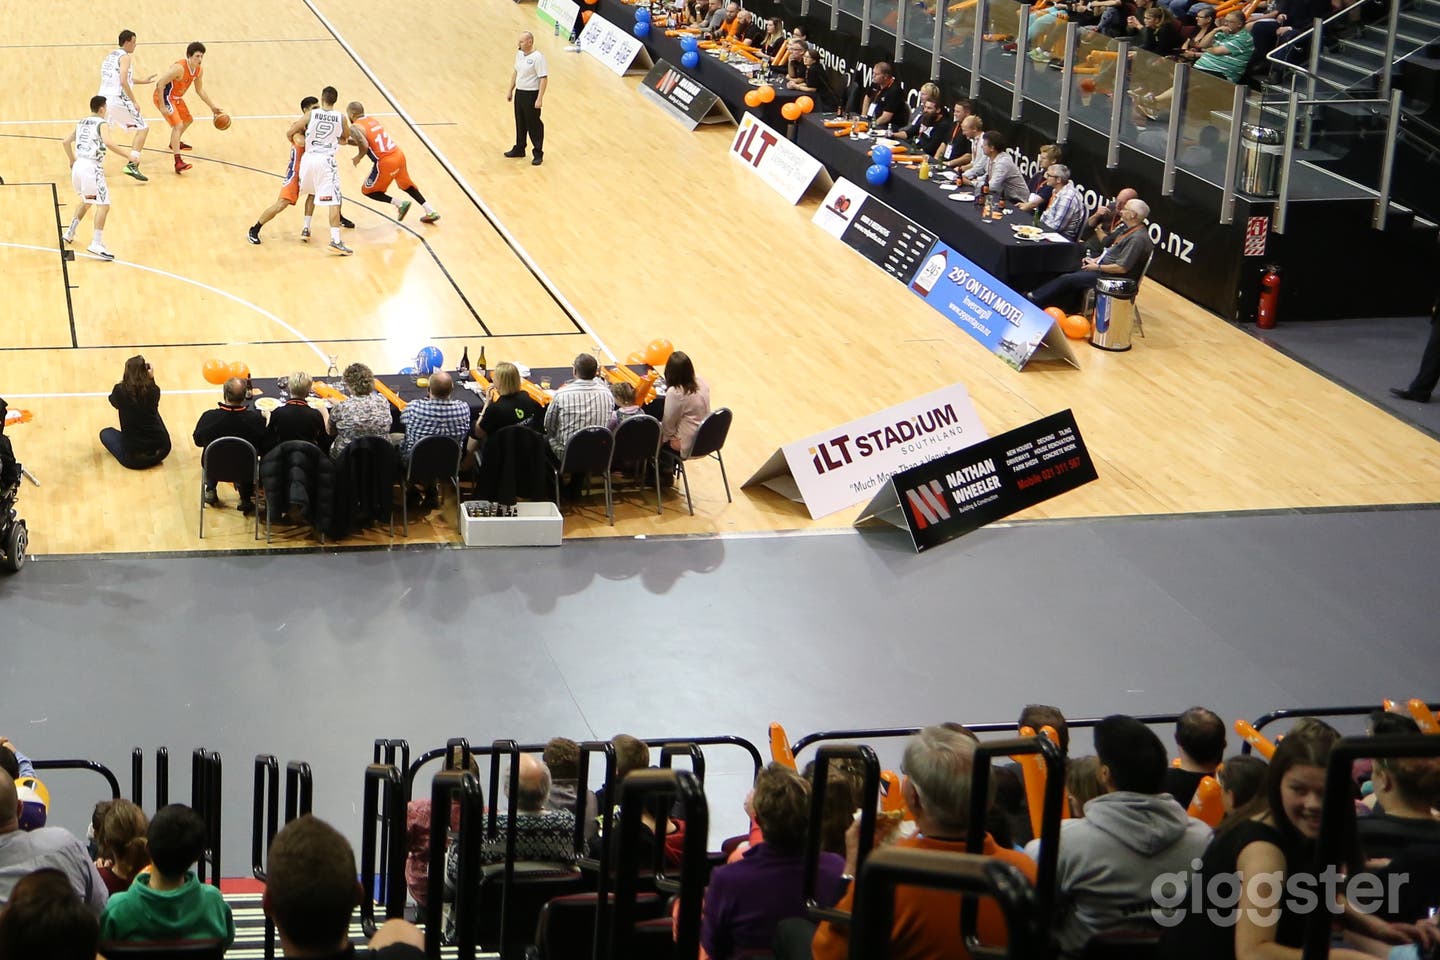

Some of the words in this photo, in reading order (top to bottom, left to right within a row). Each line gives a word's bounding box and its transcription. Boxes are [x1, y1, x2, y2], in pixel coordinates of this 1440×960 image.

[316, 122, 334, 139] 9
[375, 133, 396, 152] 12
[948, 266, 970, 286] 295
[966, 278, 982, 297] ON
[979, 286, 998, 306] TAY
[993, 297, 1024, 327] MOTEL
[962, 296, 992, 320] Invercargill
[808, 434, 852, 474] iLT
[856, 404, 958, 457] STADiUM
[902, 426, 963, 455] SOUTHLAND
[1006, 452, 1030, 466] DRIVEWAYS
[1034, 446, 1048, 455] HOUSE
[1048, 435, 1075, 449] RENOVATIONS
[1016, 442, 1033, 453] HOUSES
[1037, 434, 1055, 445] DECKING
[1013, 463, 1025, 472] FARM
[1042, 448, 1064, 460] CONCRETE
[1063, 444, 1077, 452] WORK
[945, 458, 996, 488] NATHAN
[1017, 475, 1042, 489] Mobile
[1042, 468, 1055, 480] 021
[952, 475, 1002, 504] WHEELER
